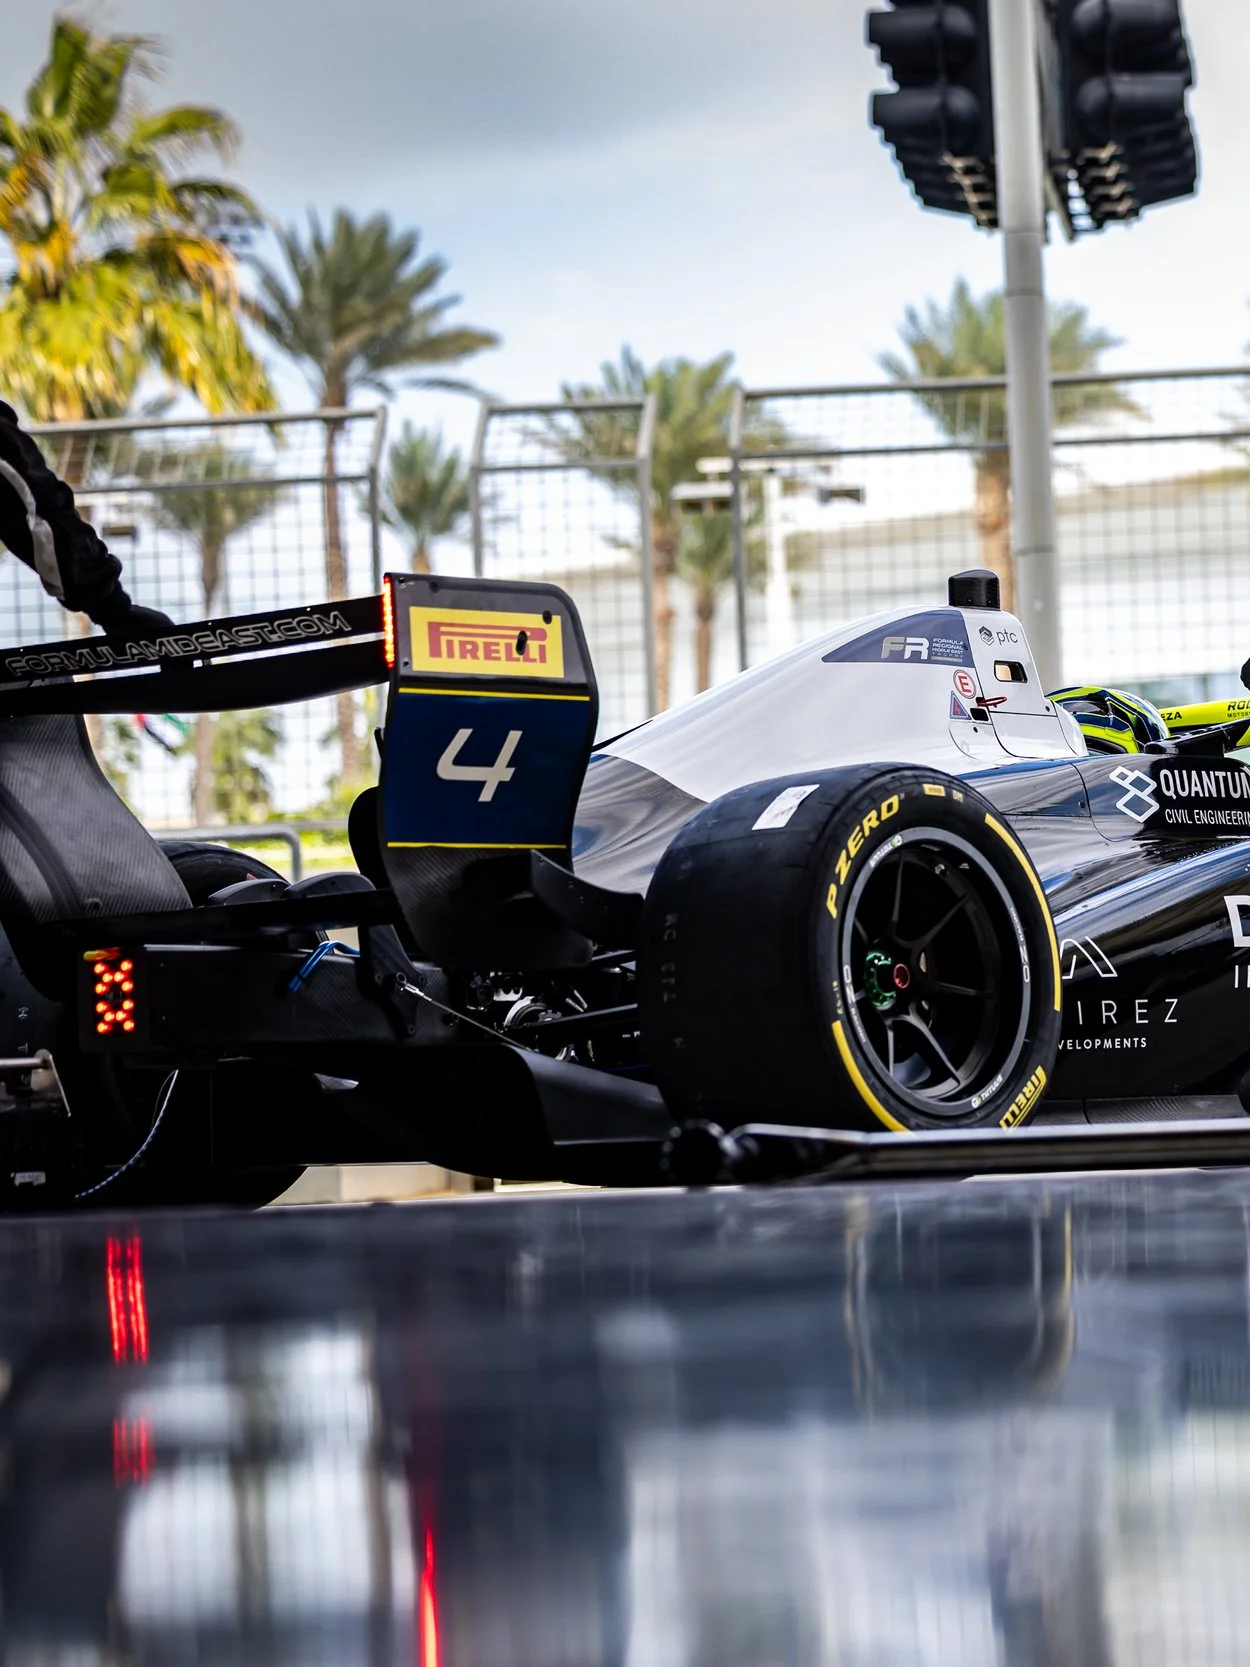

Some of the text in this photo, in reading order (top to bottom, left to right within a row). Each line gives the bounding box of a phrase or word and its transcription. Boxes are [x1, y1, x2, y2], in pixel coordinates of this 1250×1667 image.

[5, 611, 352, 678] FORMULAMIDEAST.COM
[427, 621, 548, 664] PIRELLI
[880, 636, 930, 660] FR
[932, 638, 964, 646] FORMULA
[932, 643, 964, 651] REGIONAL
[996, 628, 1019, 645] ptc
[957, 675, 972, 694] E
[436, 728, 523, 802] 4
[1165, 808, 1193, 824] CIVIL
[826, 794, 899, 919] P ZERO
[999, 1065, 1047, 1134] PIRELLI
